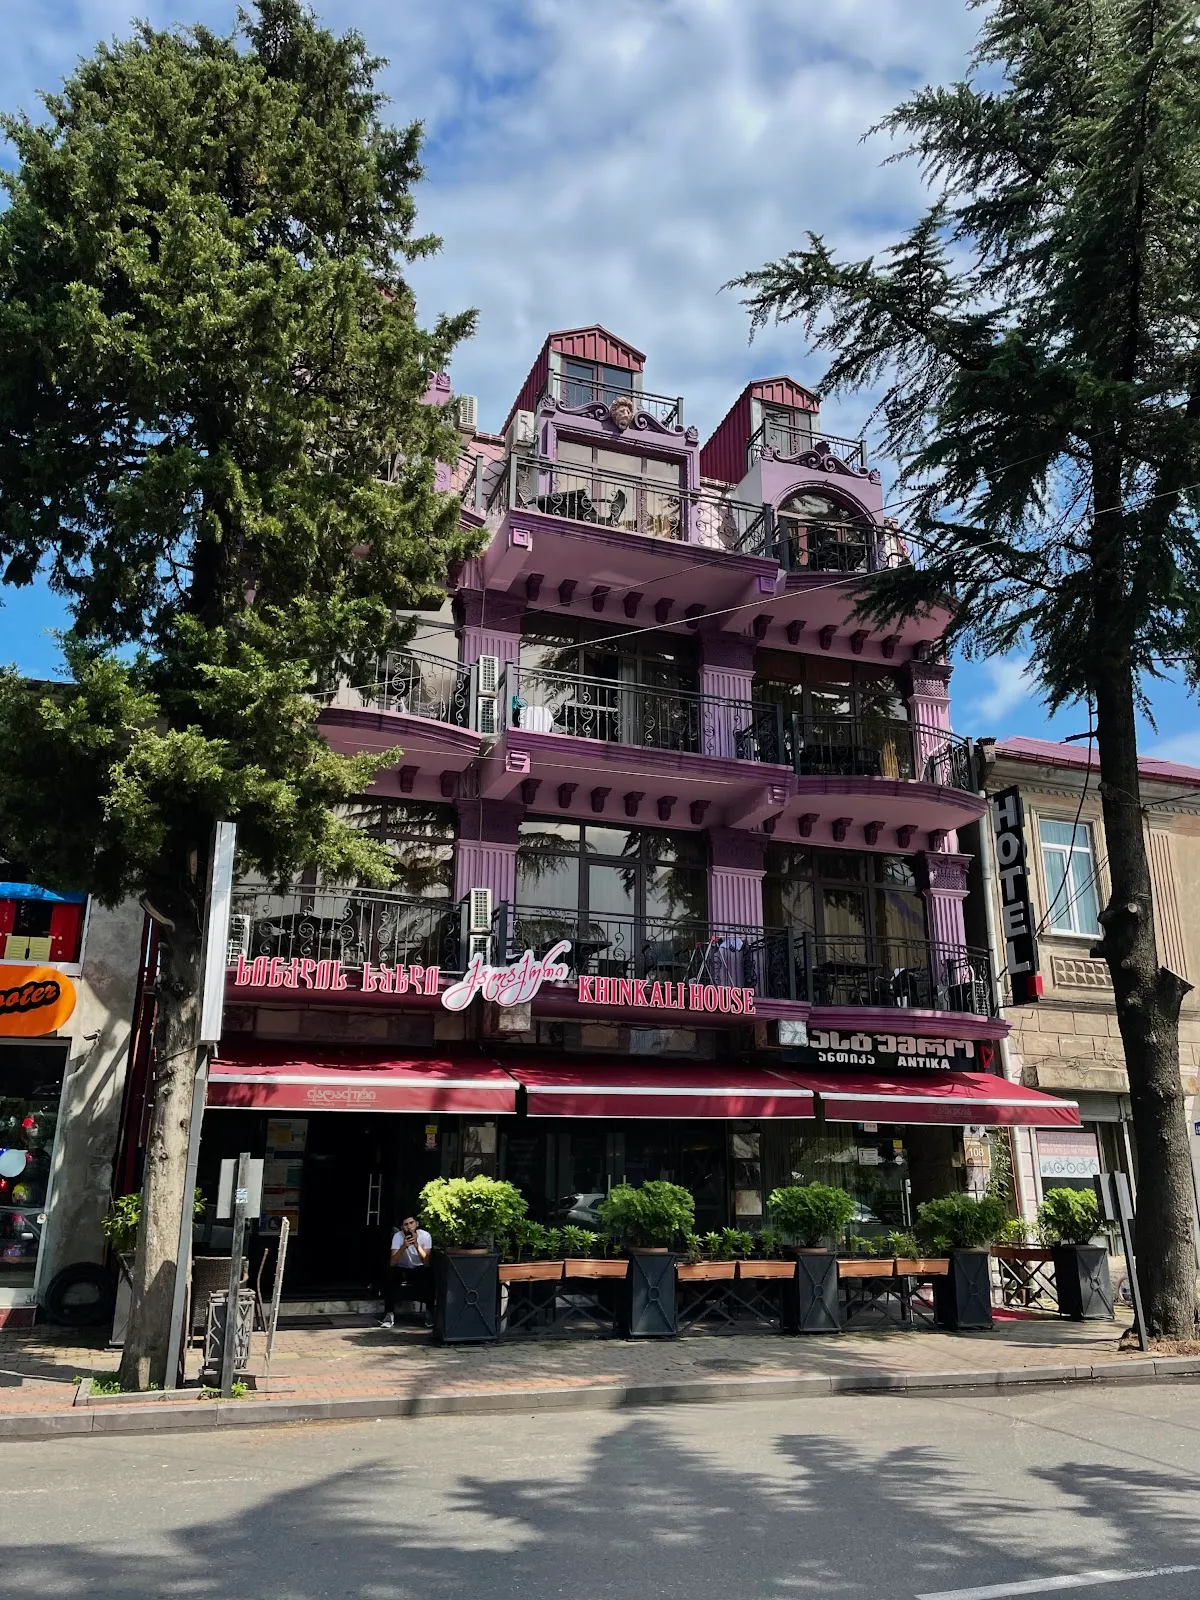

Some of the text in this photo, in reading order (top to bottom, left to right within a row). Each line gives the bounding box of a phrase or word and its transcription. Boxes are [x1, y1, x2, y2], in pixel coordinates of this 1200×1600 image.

[991, 795, 1031, 975] HOTEL
[234, 954, 441, 996] ხინკლის სახლი
[578, 975, 757, 1015] KHINKALI HOUSE
[805, 1029, 975, 1059] ასტუმრო
[897, 1056, 951, 1070] ANTIKA
[969, 1147, 984, 1157] 108
